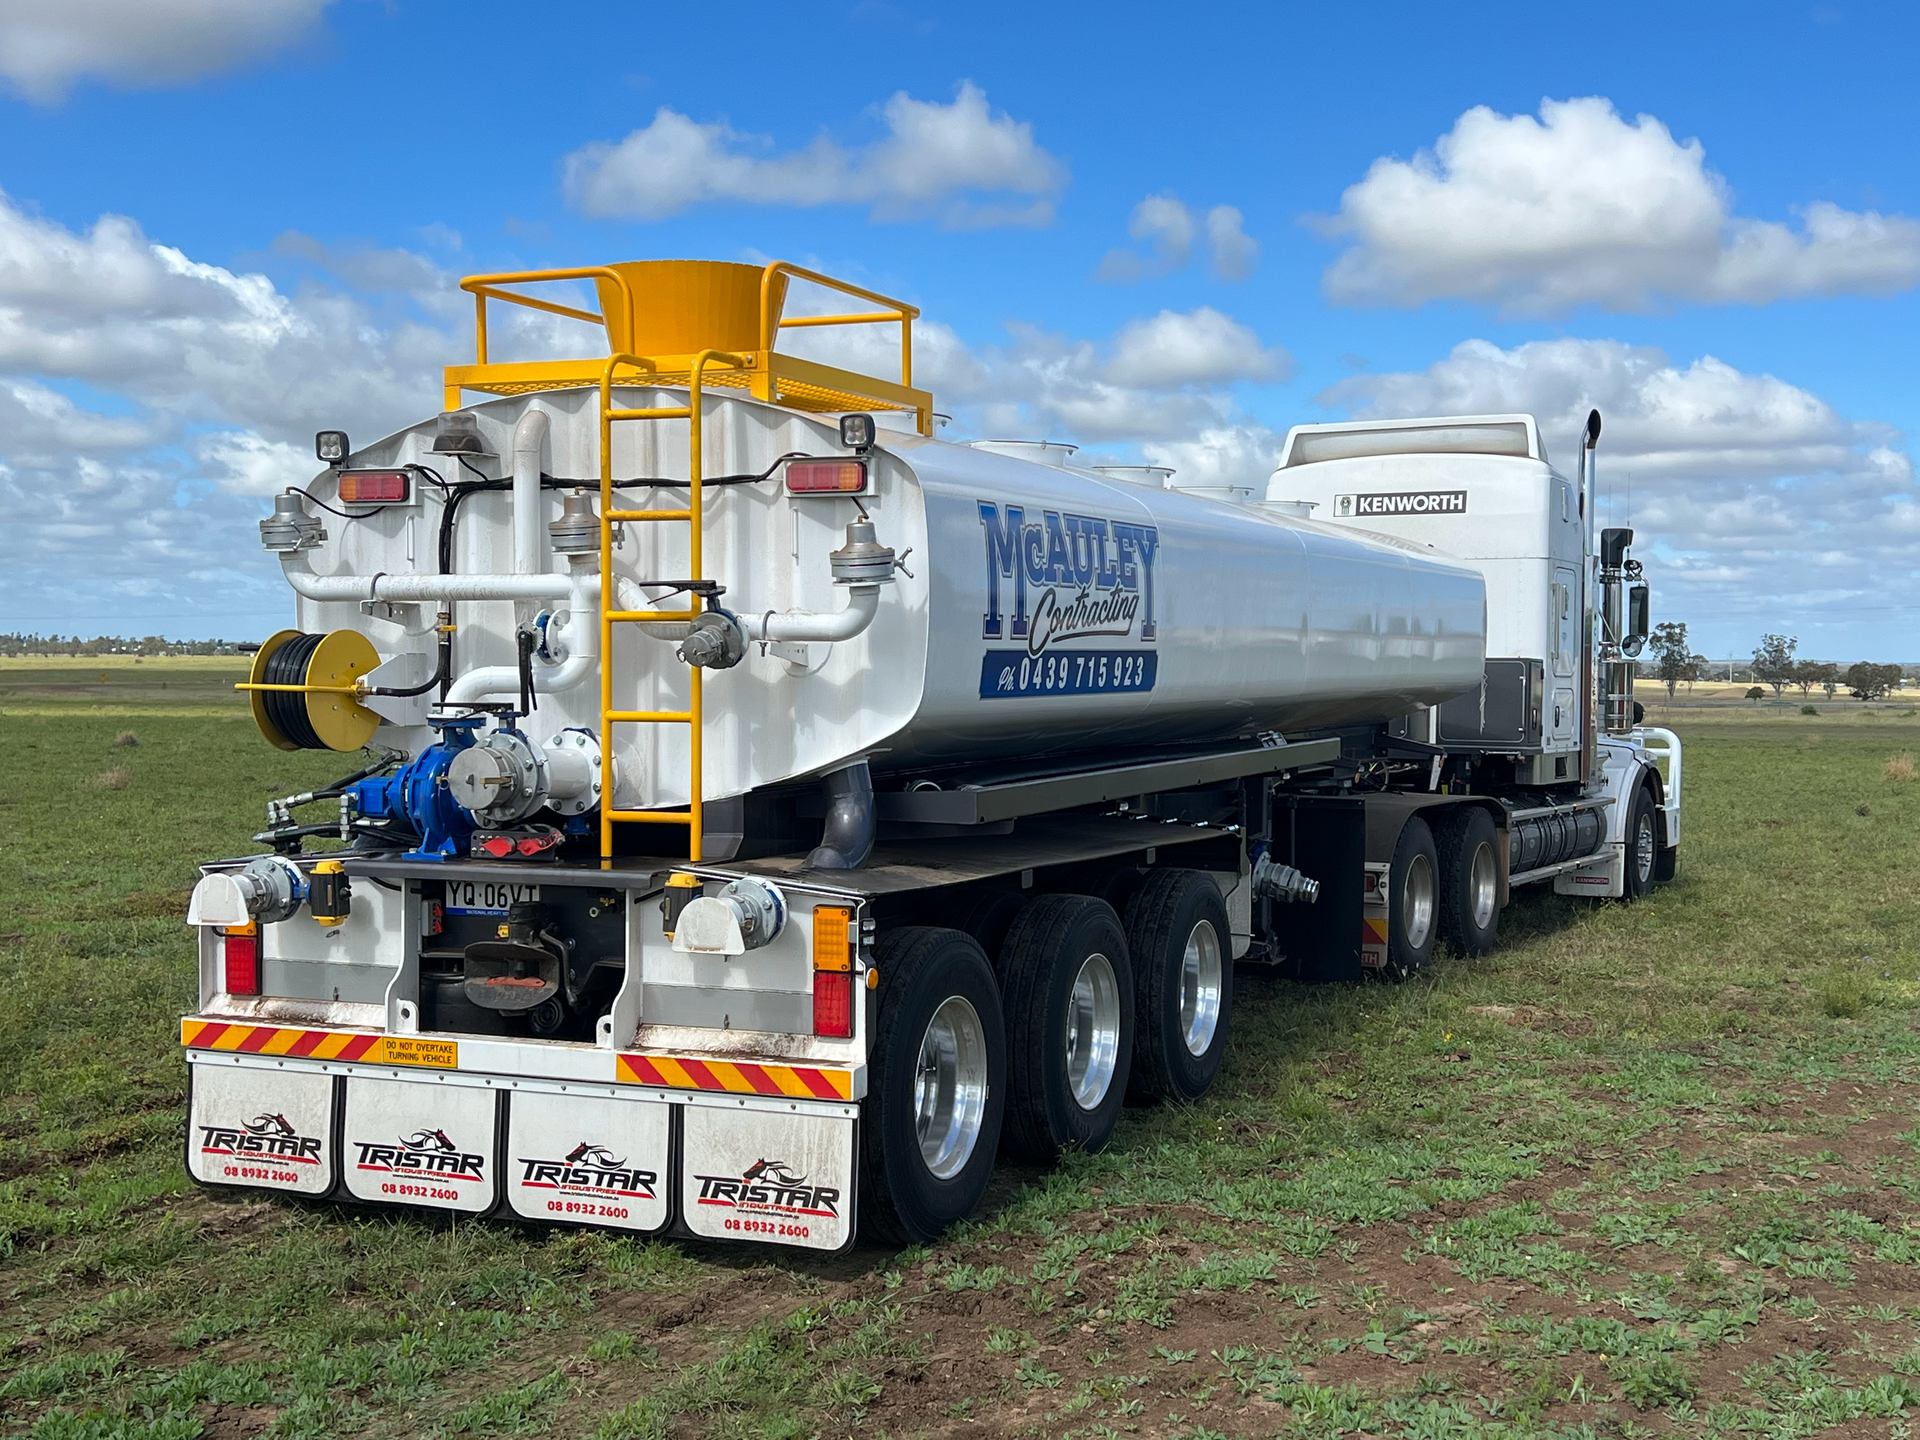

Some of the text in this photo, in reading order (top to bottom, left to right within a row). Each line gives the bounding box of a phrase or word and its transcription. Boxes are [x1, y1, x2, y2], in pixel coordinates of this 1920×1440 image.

[1360, 494, 1463, 512] KENWORTH
[1028, 580, 1140, 657] Contracting
[1019, 656, 1069, 691] 0439
[1075, 656, 1107, 688] 715
[1113, 656, 1144, 687] 923
[386, 1041, 453, 1054] DO NOT OVERTAKE
[388, 1051, 452, 1064] TURNING VEHICLE
[198, 1126, 322, 1164] TRISTAR
[353, 1142, 485, 1182] TRISTAR
[224, 1166, 298, 1183] 08 8932 2600
[517, 1158, 657, 1199] TRISTAR
[381, 1183, 458, 1200] 08 8932 2600
[693, 1175, 839, 1218] TRISTAR
[547, 1200, 629, 1219] 08 8932 2600
[724, 1219, 809, 1238] 08 8932 2600
